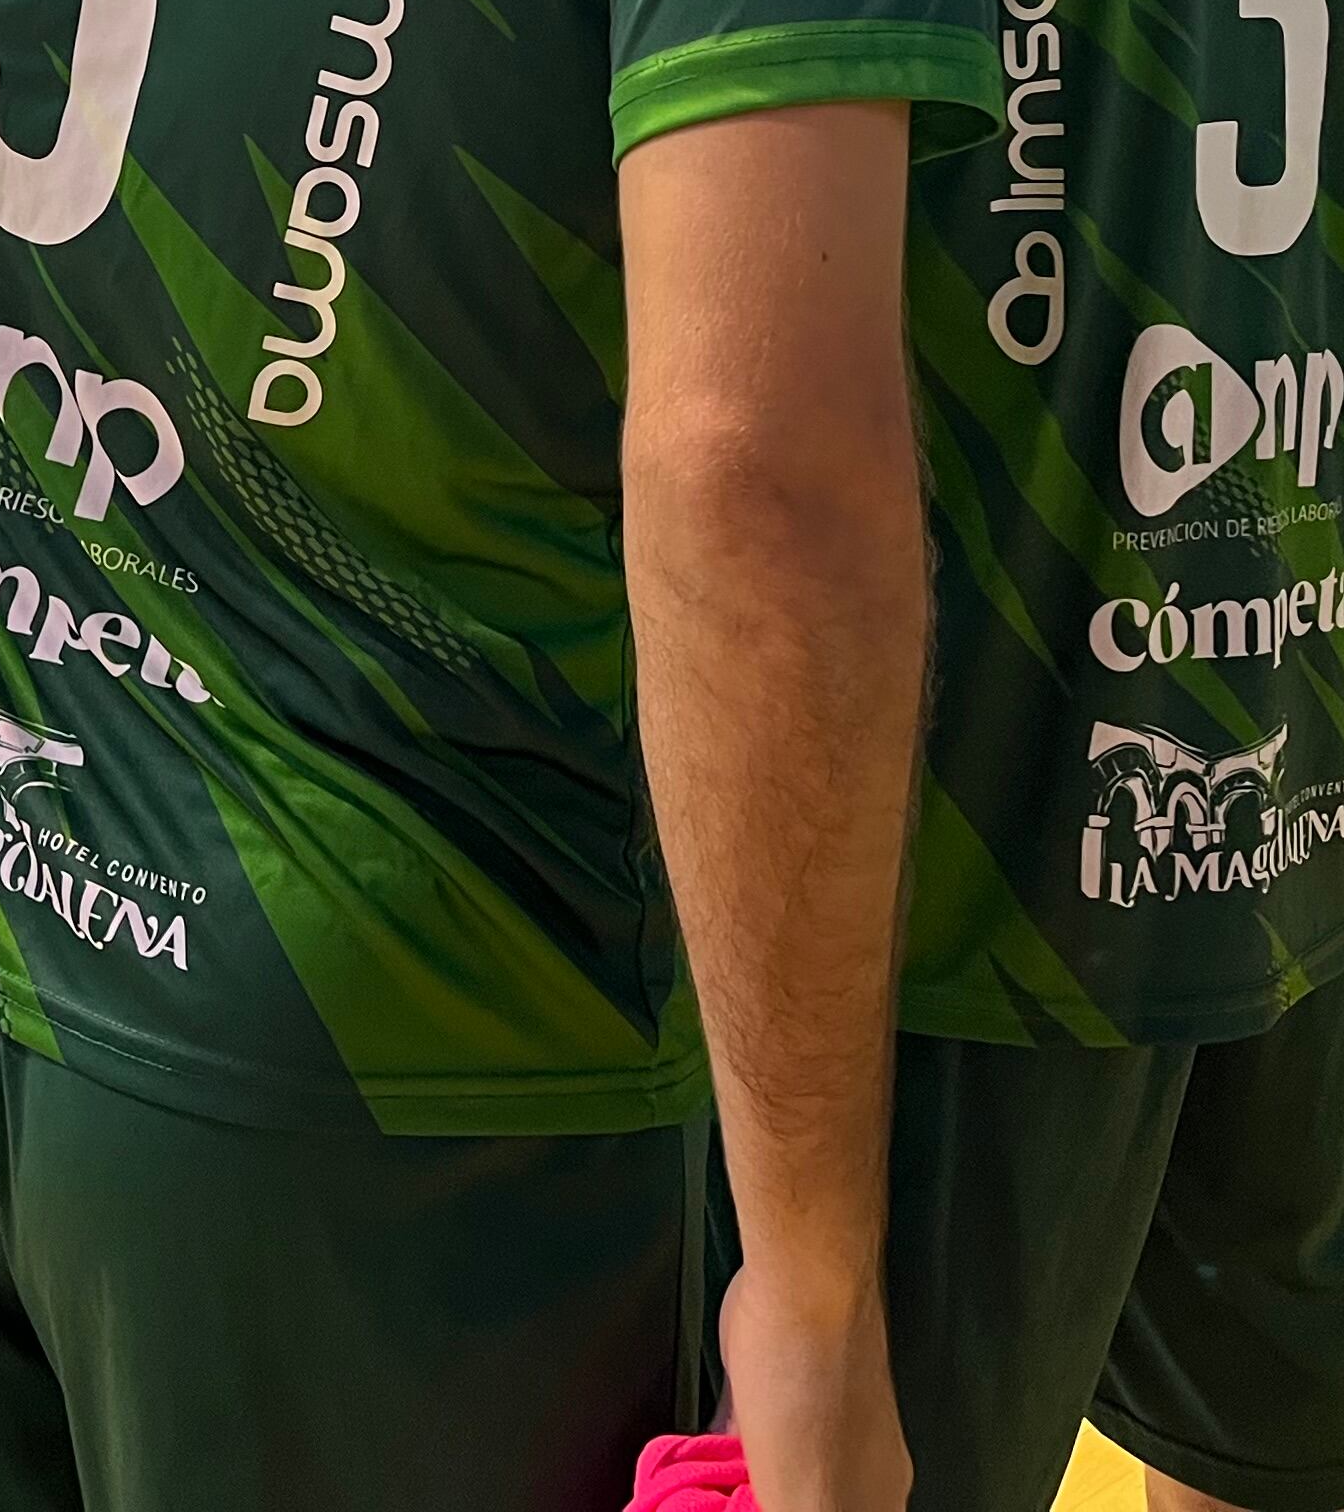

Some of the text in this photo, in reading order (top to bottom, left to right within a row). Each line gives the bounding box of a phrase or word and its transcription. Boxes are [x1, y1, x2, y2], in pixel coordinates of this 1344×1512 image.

[1112, 519, 1219, 551] PREVENCION
[1226, 517, 1252, 538] DE
[37, 826, 207, 905] HOTEL CONVENTO
